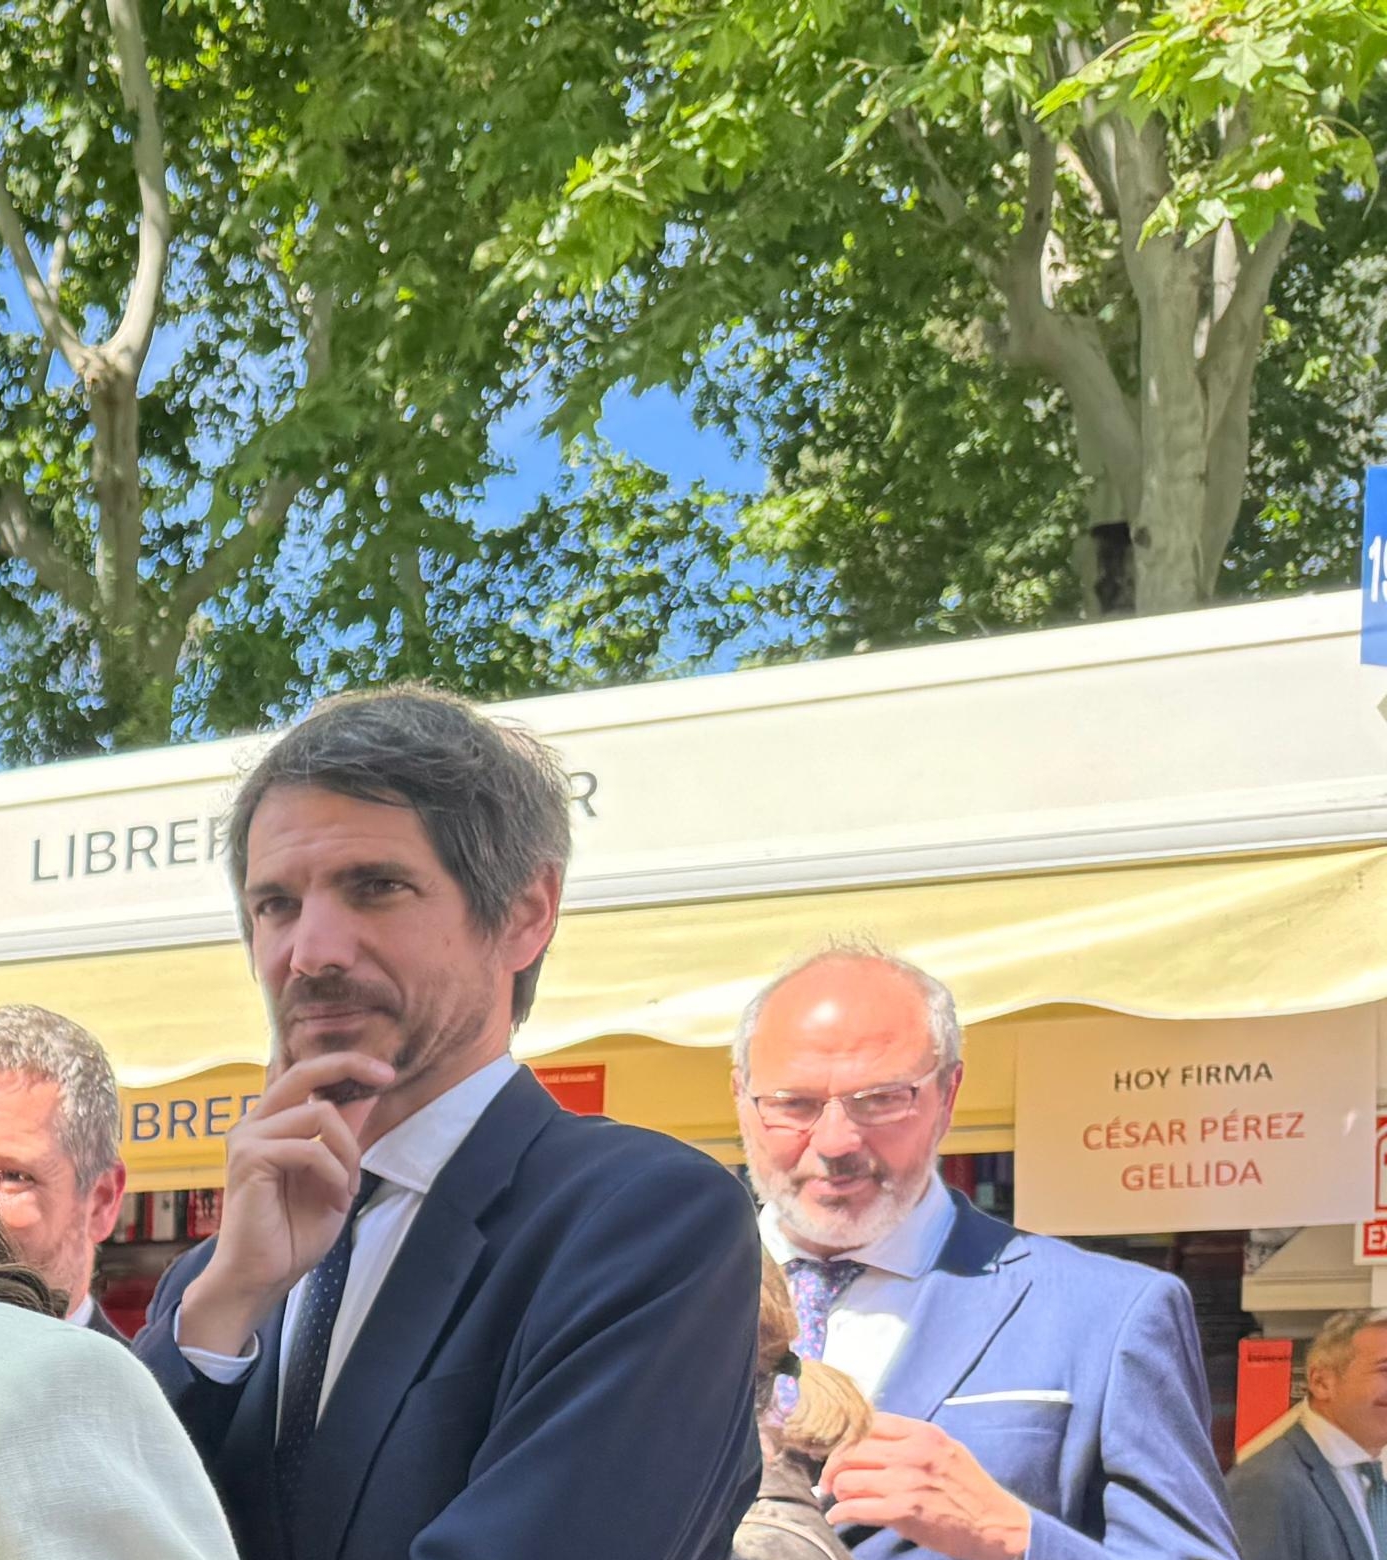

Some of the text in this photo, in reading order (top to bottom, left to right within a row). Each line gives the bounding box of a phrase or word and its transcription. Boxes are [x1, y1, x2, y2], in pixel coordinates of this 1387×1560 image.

[29, 815, 225, 883] LIBRE
[1113, 1062, 1274, 1092] HOY FIRMA
[1082, 1108, 1306, 1152] CÉSAR PÉREZ
[1120, 1161, 1263, 1192] GELLIDA
